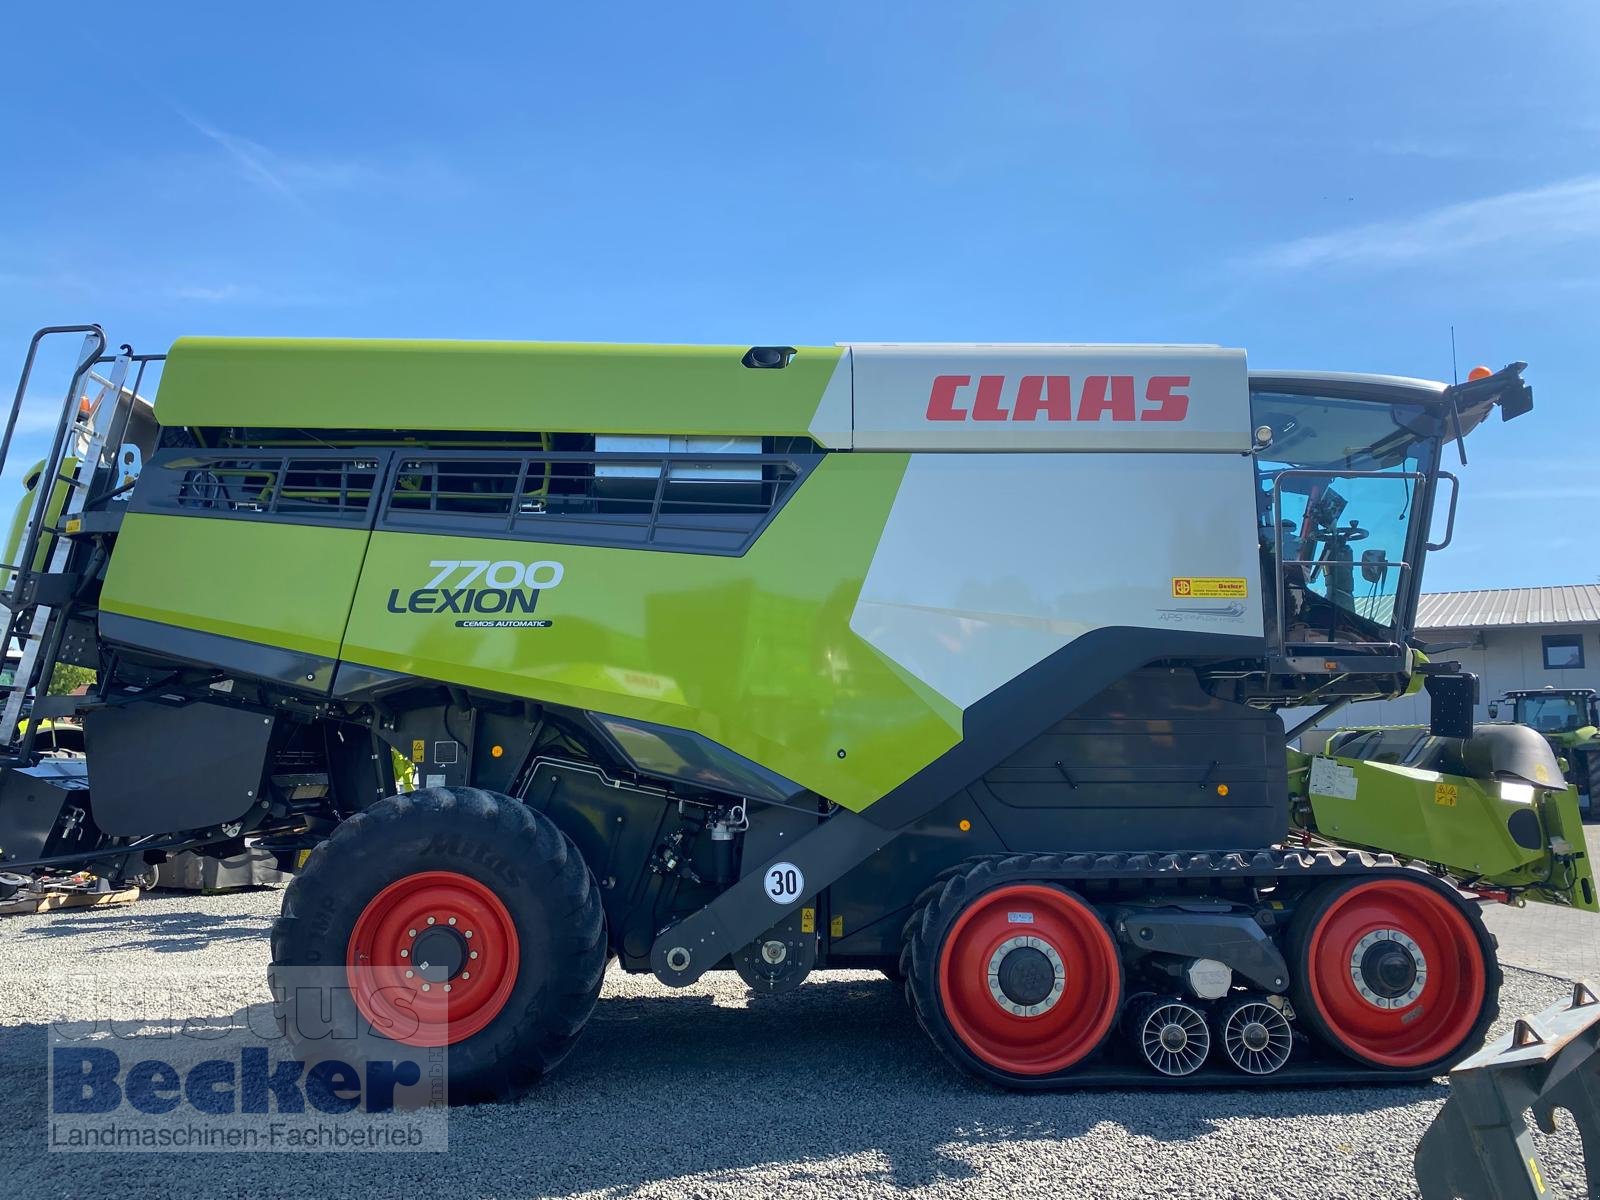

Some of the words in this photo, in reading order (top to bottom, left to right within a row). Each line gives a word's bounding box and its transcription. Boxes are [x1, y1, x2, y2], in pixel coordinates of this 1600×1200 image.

[925, 375, 1191, 422] CLAAS
[423, 560, 565, 590] 7700
[387, 588, 541, 614] LEXION
[463, 620, 495, 628] CEMOS
[496, 620, 546, 628] AUTOMATIC
[771, 869, 797, 896] 30
